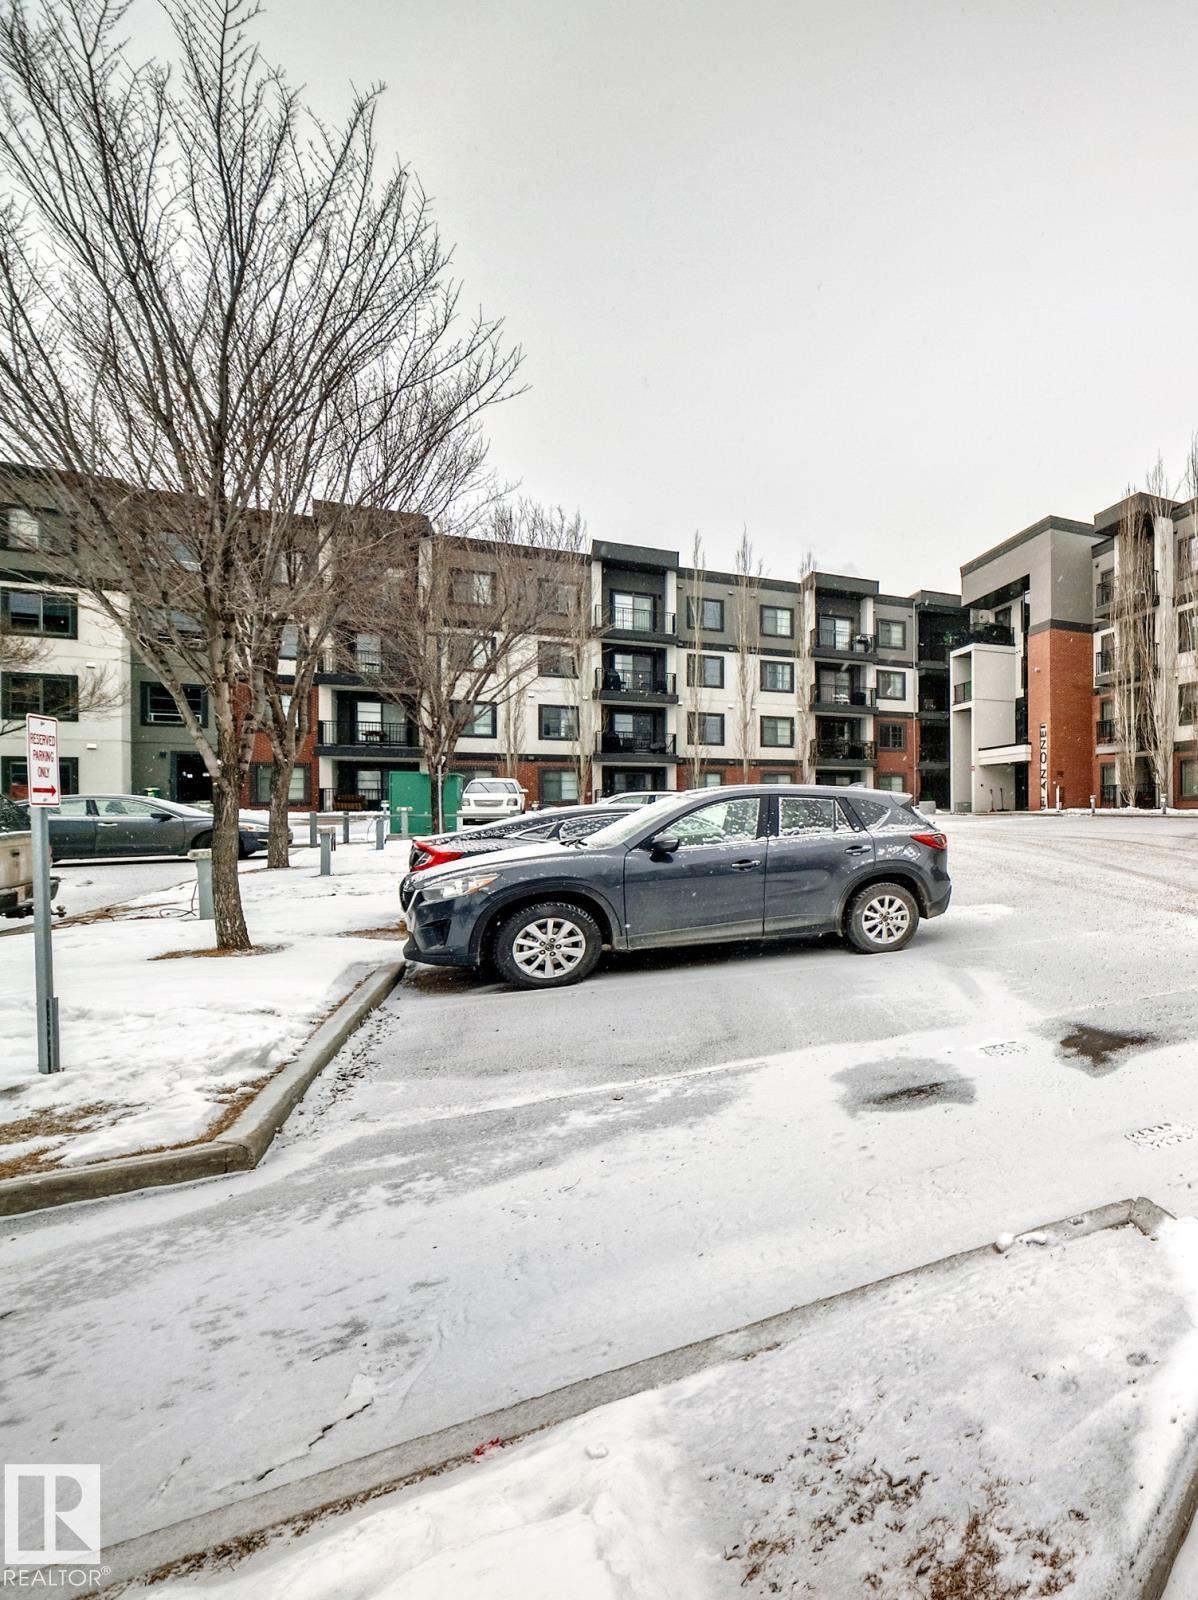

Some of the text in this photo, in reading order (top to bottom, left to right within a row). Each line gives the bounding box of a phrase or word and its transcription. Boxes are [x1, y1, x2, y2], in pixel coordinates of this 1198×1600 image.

[30, 732, 55, 746] RESERVED
[33, 749, 54, 762] PARKING
[38, 766, 49, 778] ONLY
